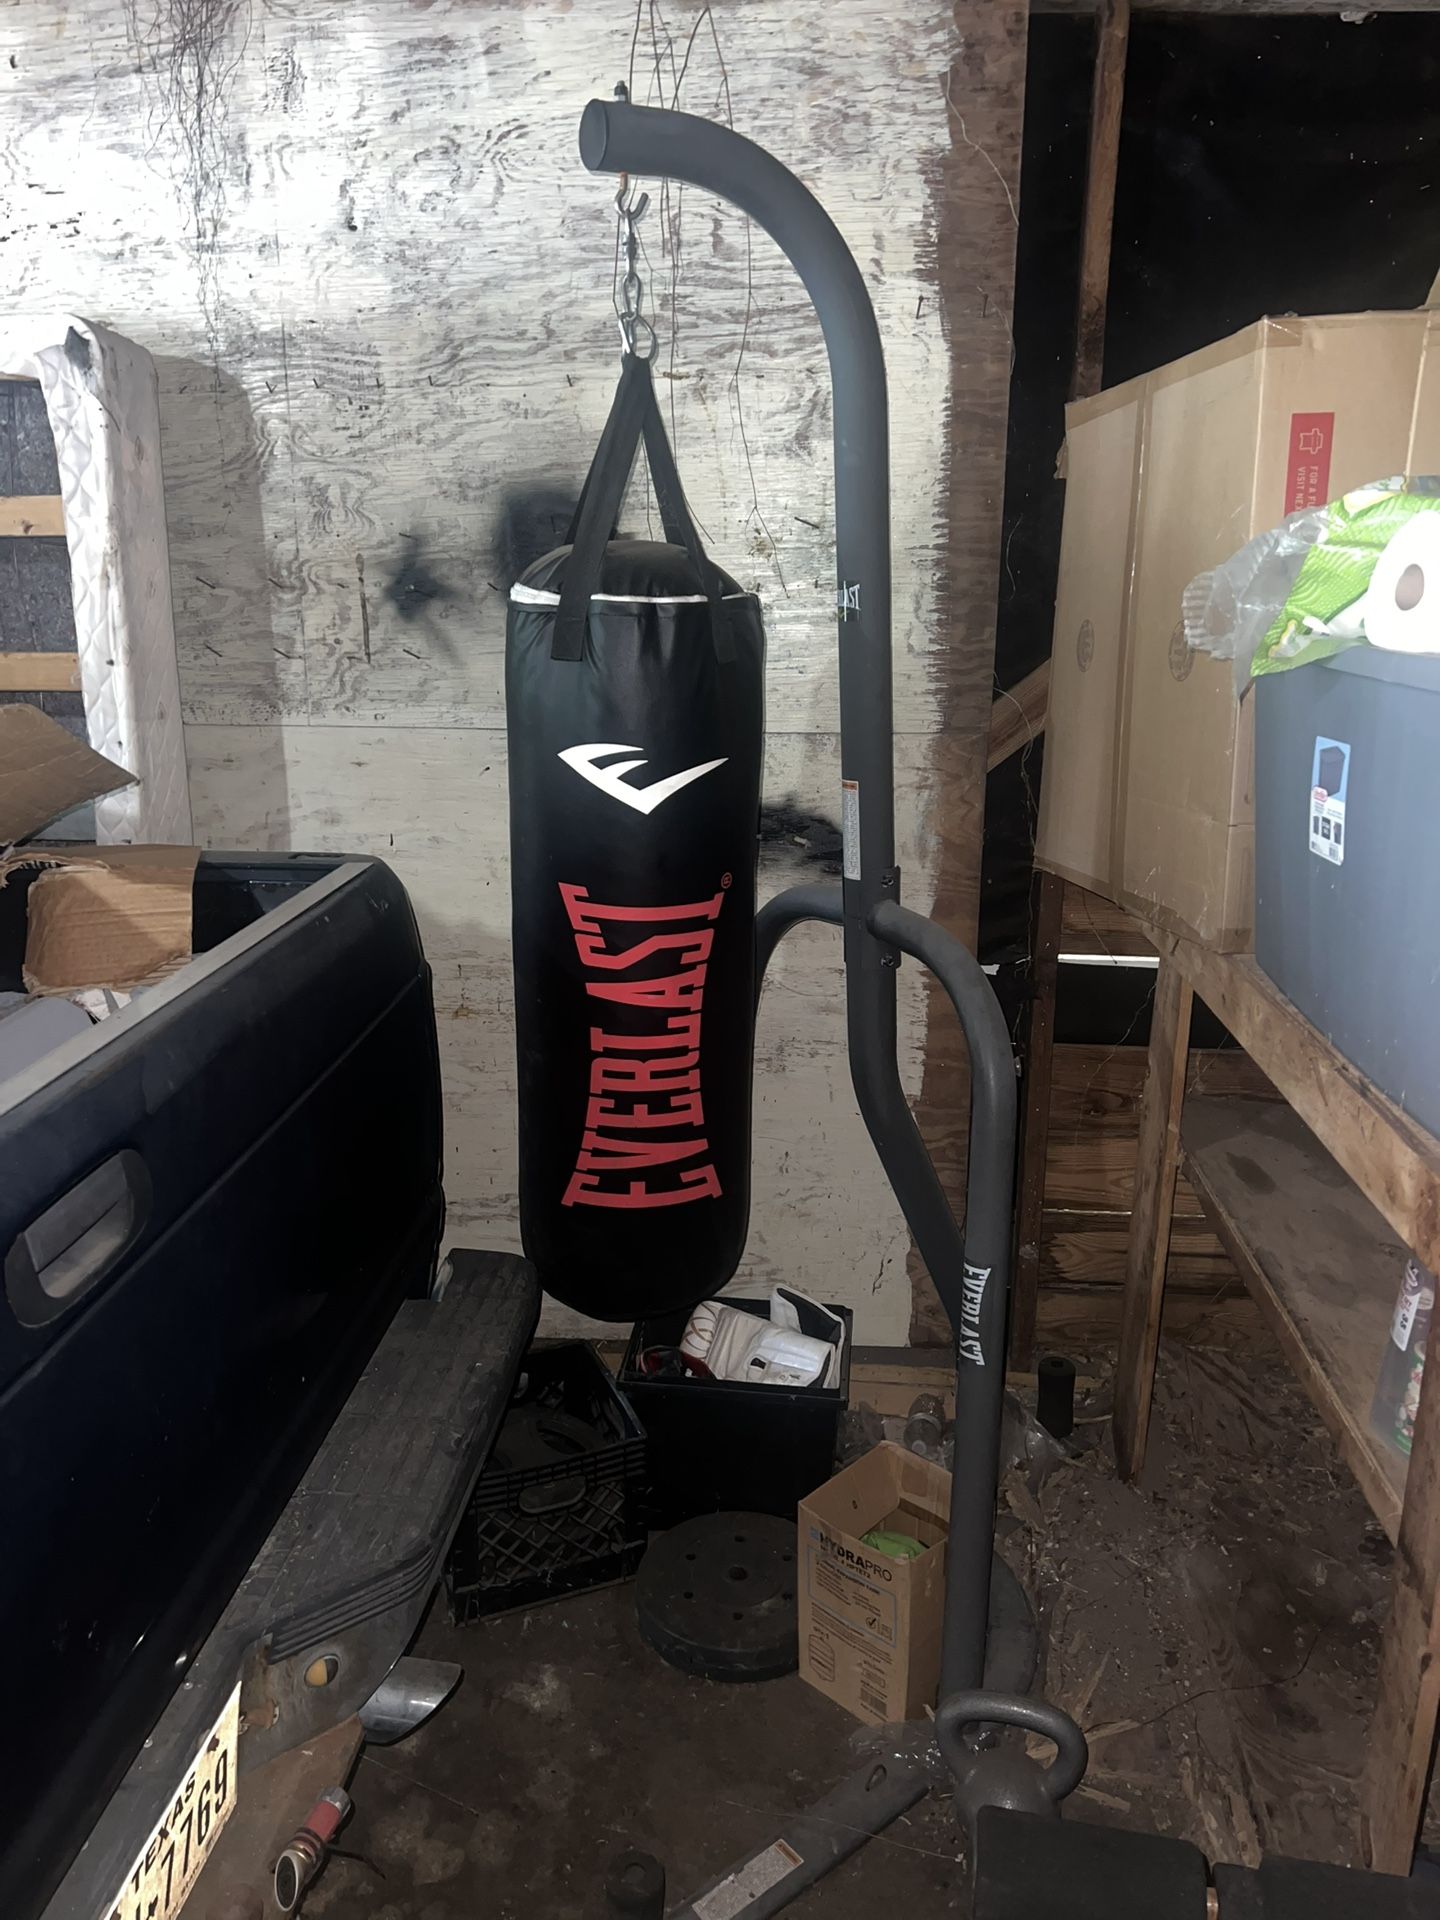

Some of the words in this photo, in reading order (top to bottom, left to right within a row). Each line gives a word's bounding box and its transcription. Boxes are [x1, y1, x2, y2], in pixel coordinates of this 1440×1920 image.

[1296, 465, 1306, 489] VISIT
[1309, 465, 1319, 485] FOR
[558, 882, 724, 1208] EVERLAST
[960, 1262, 991, 1366] EVERLAST
[820, 1531, 892, 1582] HYDRAPRO
[131, 1771, 196, 1894] TEXAS
